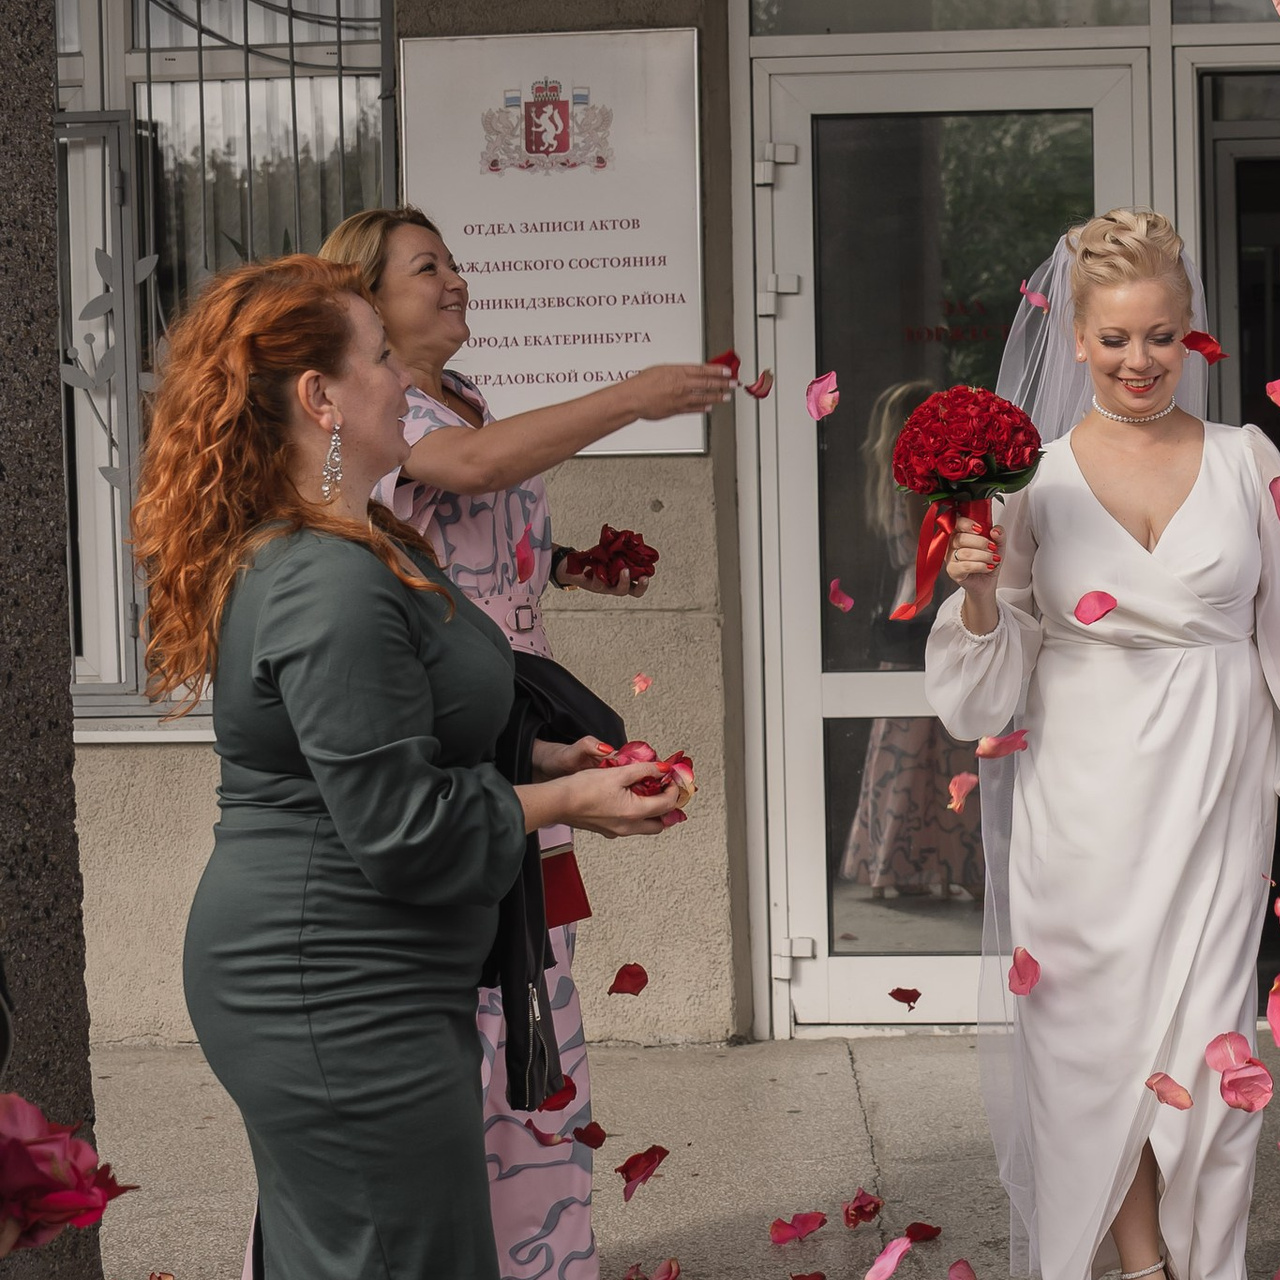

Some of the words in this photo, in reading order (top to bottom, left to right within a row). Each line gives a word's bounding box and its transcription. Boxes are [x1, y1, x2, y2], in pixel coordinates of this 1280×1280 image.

[463, 222, 516, 237] ОТДЕЛ
[519, 220, 585, 234] ЗАПИСИ
[589, 218, 641, 231] АКТОВ
[457, 258, 564, 274] АЖДАНСКОГО
[568, 255, 668, 270] СОСТОЯНИЯ
[467, 294, 618, 311] ОНИКИДЗЕВСКОГО
[621, 291, 687, 306] РАЙОНА
[464, 335, 519, 349] ОРОДА
[524, 332, 652, 347] ЕКАТЕРИНБУРГА
[467, 369, 579, 387] ЕРДЛОВСКОЙ
[583, 369, 642, 383] ОБЛАС
